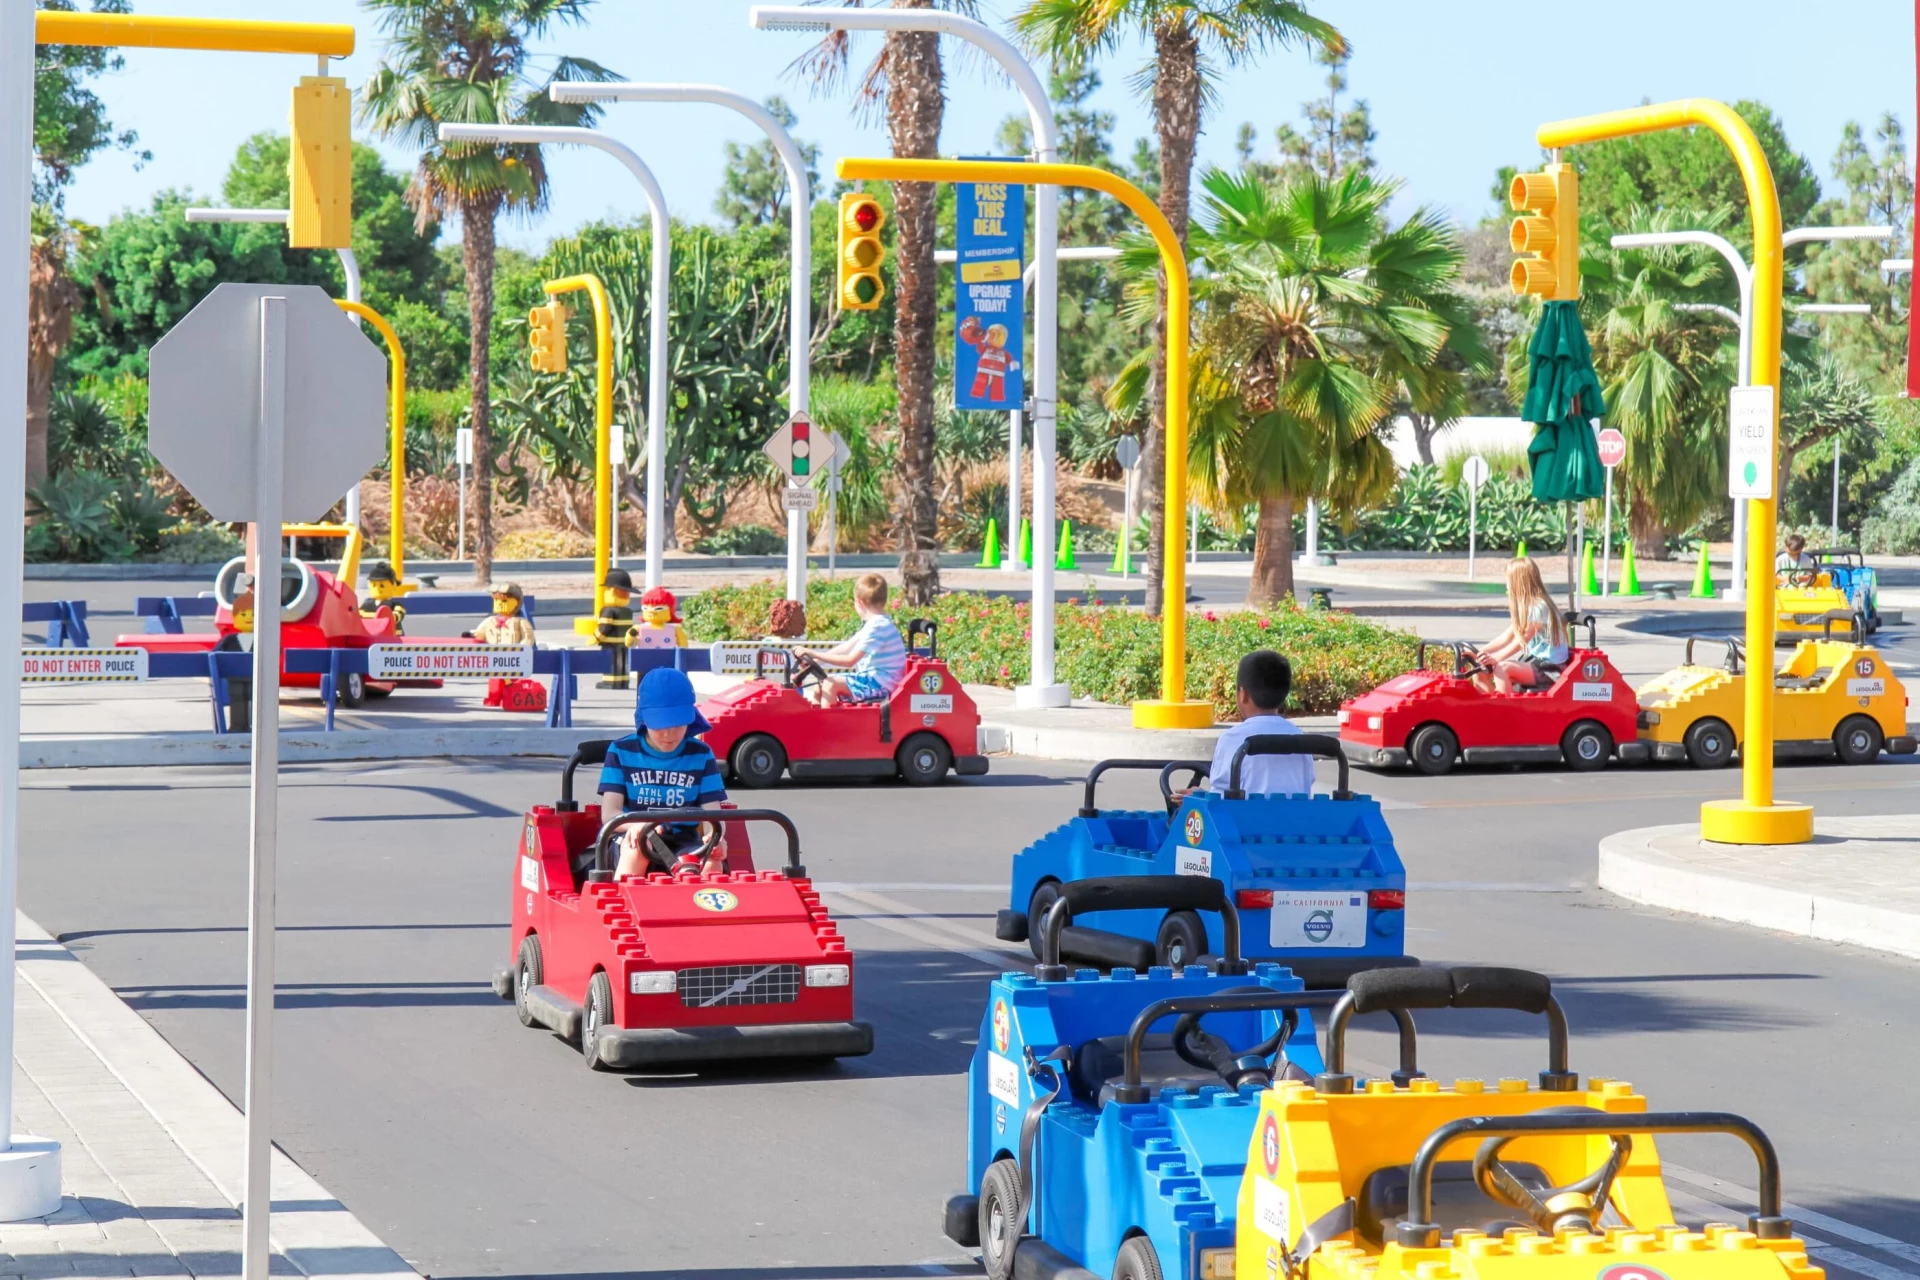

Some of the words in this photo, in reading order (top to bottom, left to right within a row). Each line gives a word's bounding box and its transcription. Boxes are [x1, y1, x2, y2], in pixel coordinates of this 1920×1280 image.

[975, 184, 1007, 201] PASS
[977, 201, 1004, 218] THIS
[974, 218, 1007, 236] DEAL.
[965, 247, 1015, 257] MEMBERSHIP
[969, 284, 1012, 298] UPGRADE
[973, 298, 1007, 312] TODAY!
[1739, 425, 1765, 438] YIELD
[384, 657, 412, 667] POLICE
[416, 656, 430, 668] DO
[434, 656, 454, 668] NOT
[457, 656, 489, 668] ENTER
[493, 657, 521, 667] POLICE
[725, 654, 752, 664] POLICE
[24, 660, 39, 673] DO
[42, 660, 64, 673] NOT
[67, 660, 101, 673] ENTER
[105, 661, 134, 671] POLICE
[1586, 663, 1599, 677] 11
[1857, 661, 1872, 675] 15
[923, 676, 939, 689] 36
[513, 693, 545, 706] GAS
[630, 770, 695, 789] HILFIGER
[638, 787, 662, 797] ATHL
[665, 788, 686, 807] 85
[637, 796, 662, 806] DEPT
[1188, 817, 1201, 838] 29
[1184, 862, 1210, 873] LEGOLAND
[1266, 1126, 1276, 1166] 6
